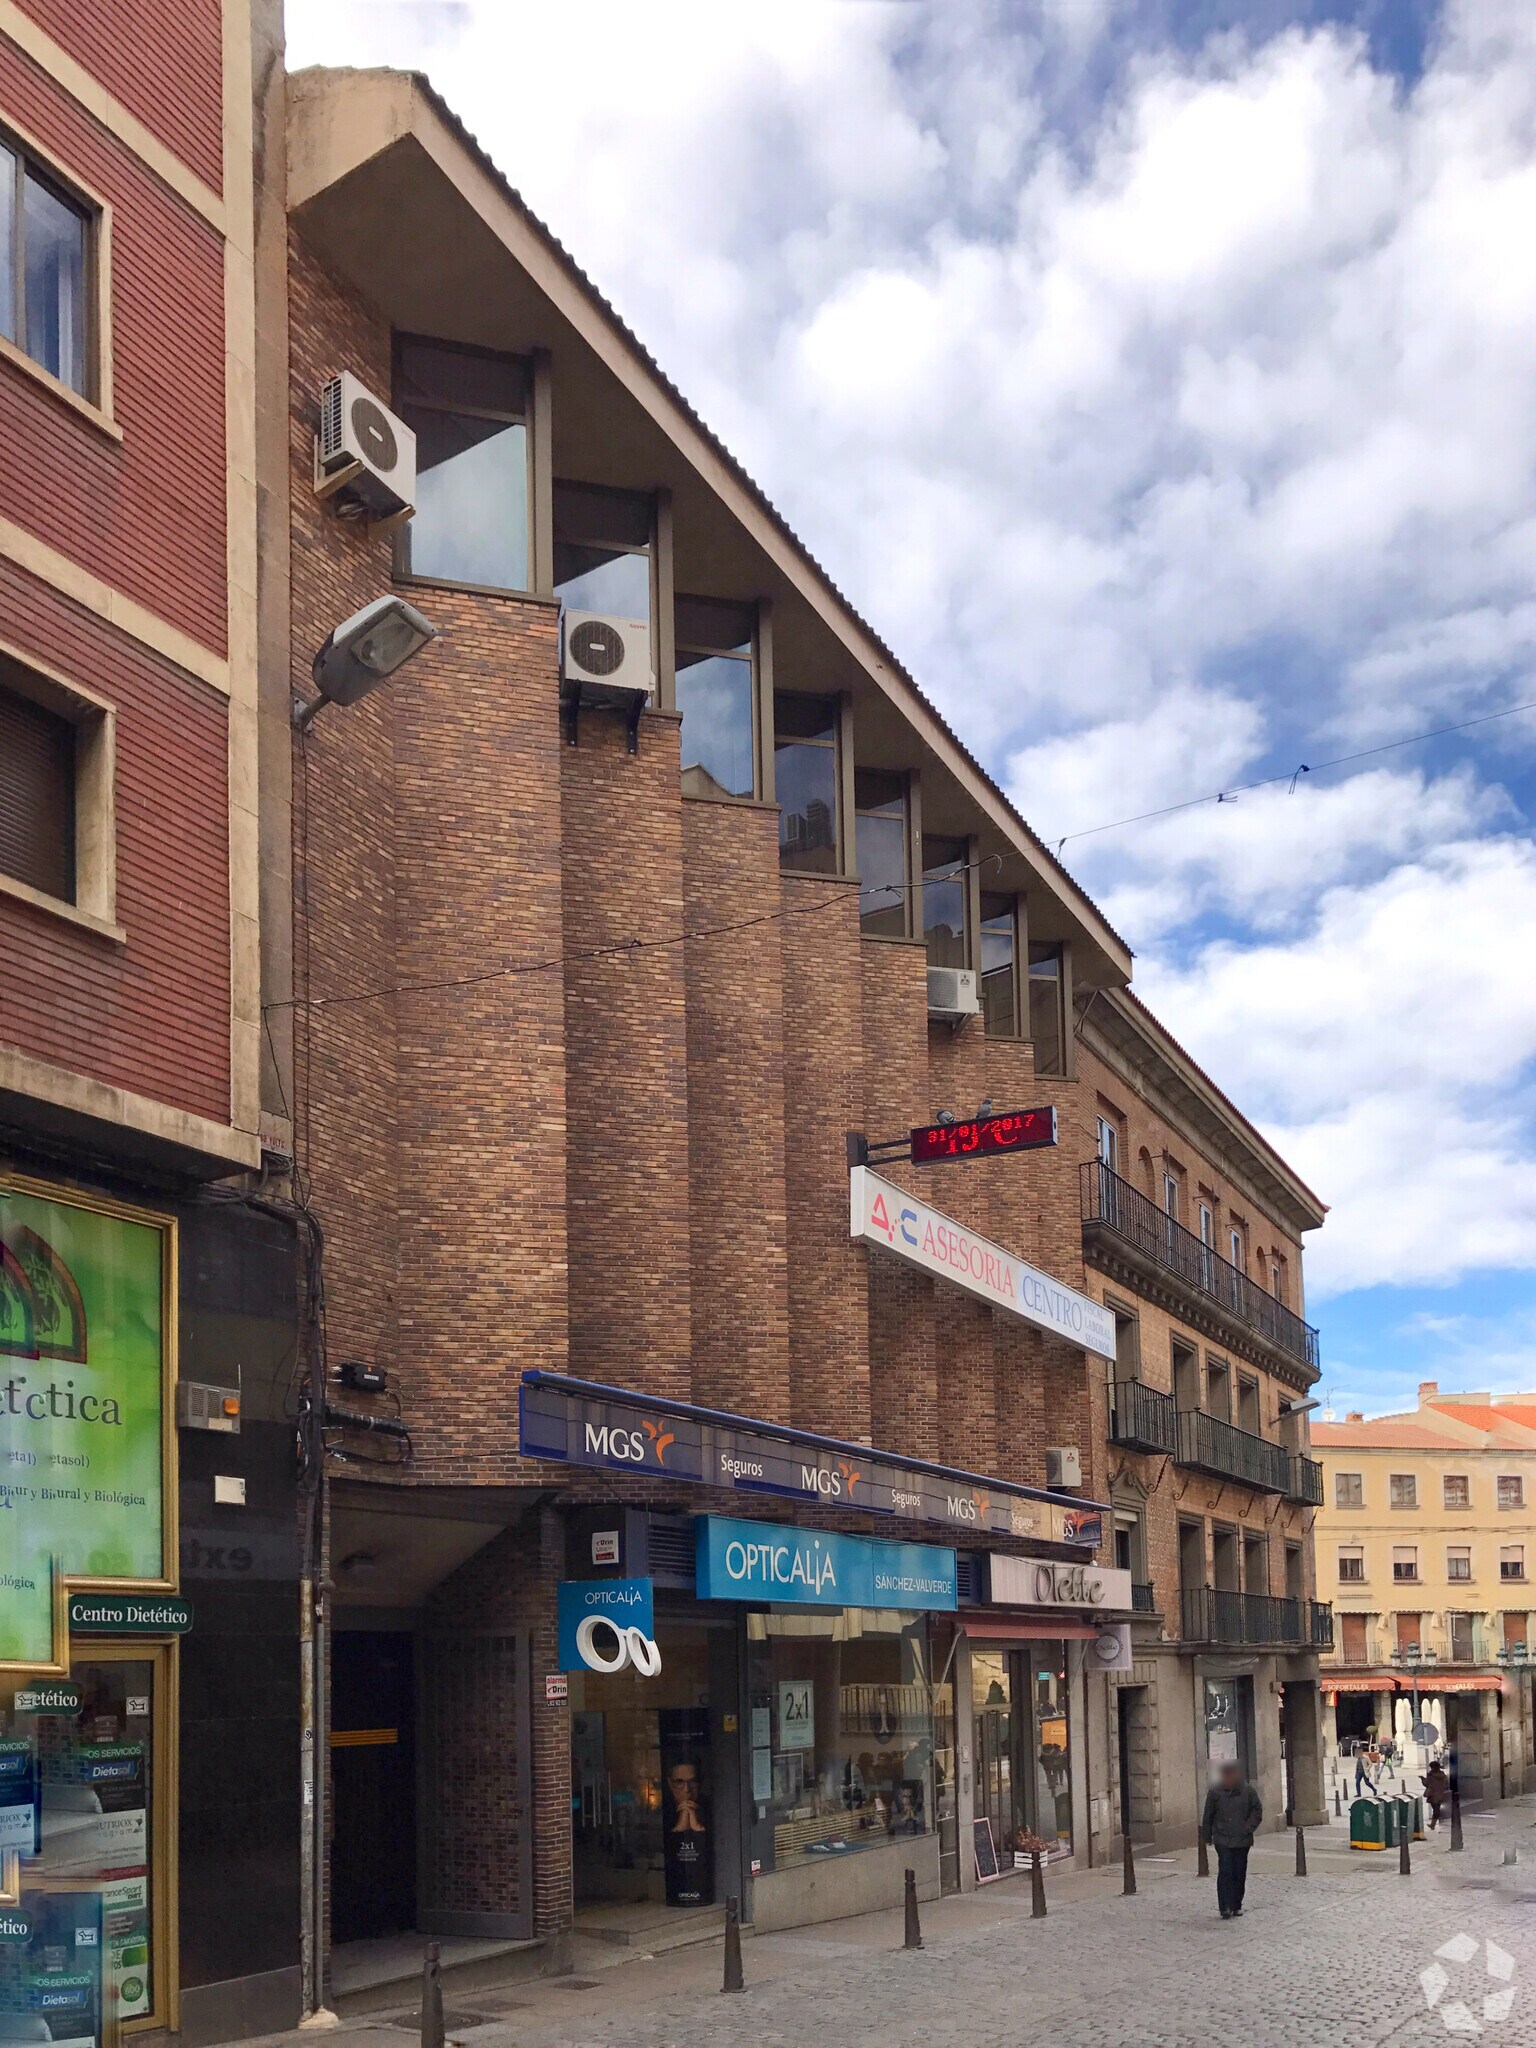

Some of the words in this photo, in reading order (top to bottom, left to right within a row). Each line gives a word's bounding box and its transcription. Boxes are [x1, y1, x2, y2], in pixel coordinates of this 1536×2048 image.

[922, 1219, 1015, 1298] ASESORIA
[1022, 1275, 1083, 1332] CENTRO
[585, 1422, 645, 1462] MGS
[720, 1453, 764, 1478] Seguros
[801, 1464, 842, 1496] MGS
[891, 1488, 921, 1510] Seguros
[947, 1495, 976, 1521] MGS
[1011, 1512, 1034, 1530] Seguros
[1052, 1518, 1074, 1538] MGS
[94, 1489, 146, 1508] Biológica
[875, 1571, 952, 1595] SÁNCHEZ-VALVERDE
[72, 1604, 123, 1622] Centro
[126, 1606, 188, 1624] Dietético
[552, 1685, 567, 1694] Drin
[785, 1691, 809, 1721] 2x1
[101, 1746, 142, 1758] SERVICIOS
[92, 1762, 132, 1777] Dietasol
[680, 1841, 694, 1850] 2x1
[51, 1975, 91, 1987] SERVICIOS
[42, 1991, 81, 2005] Dietasol
